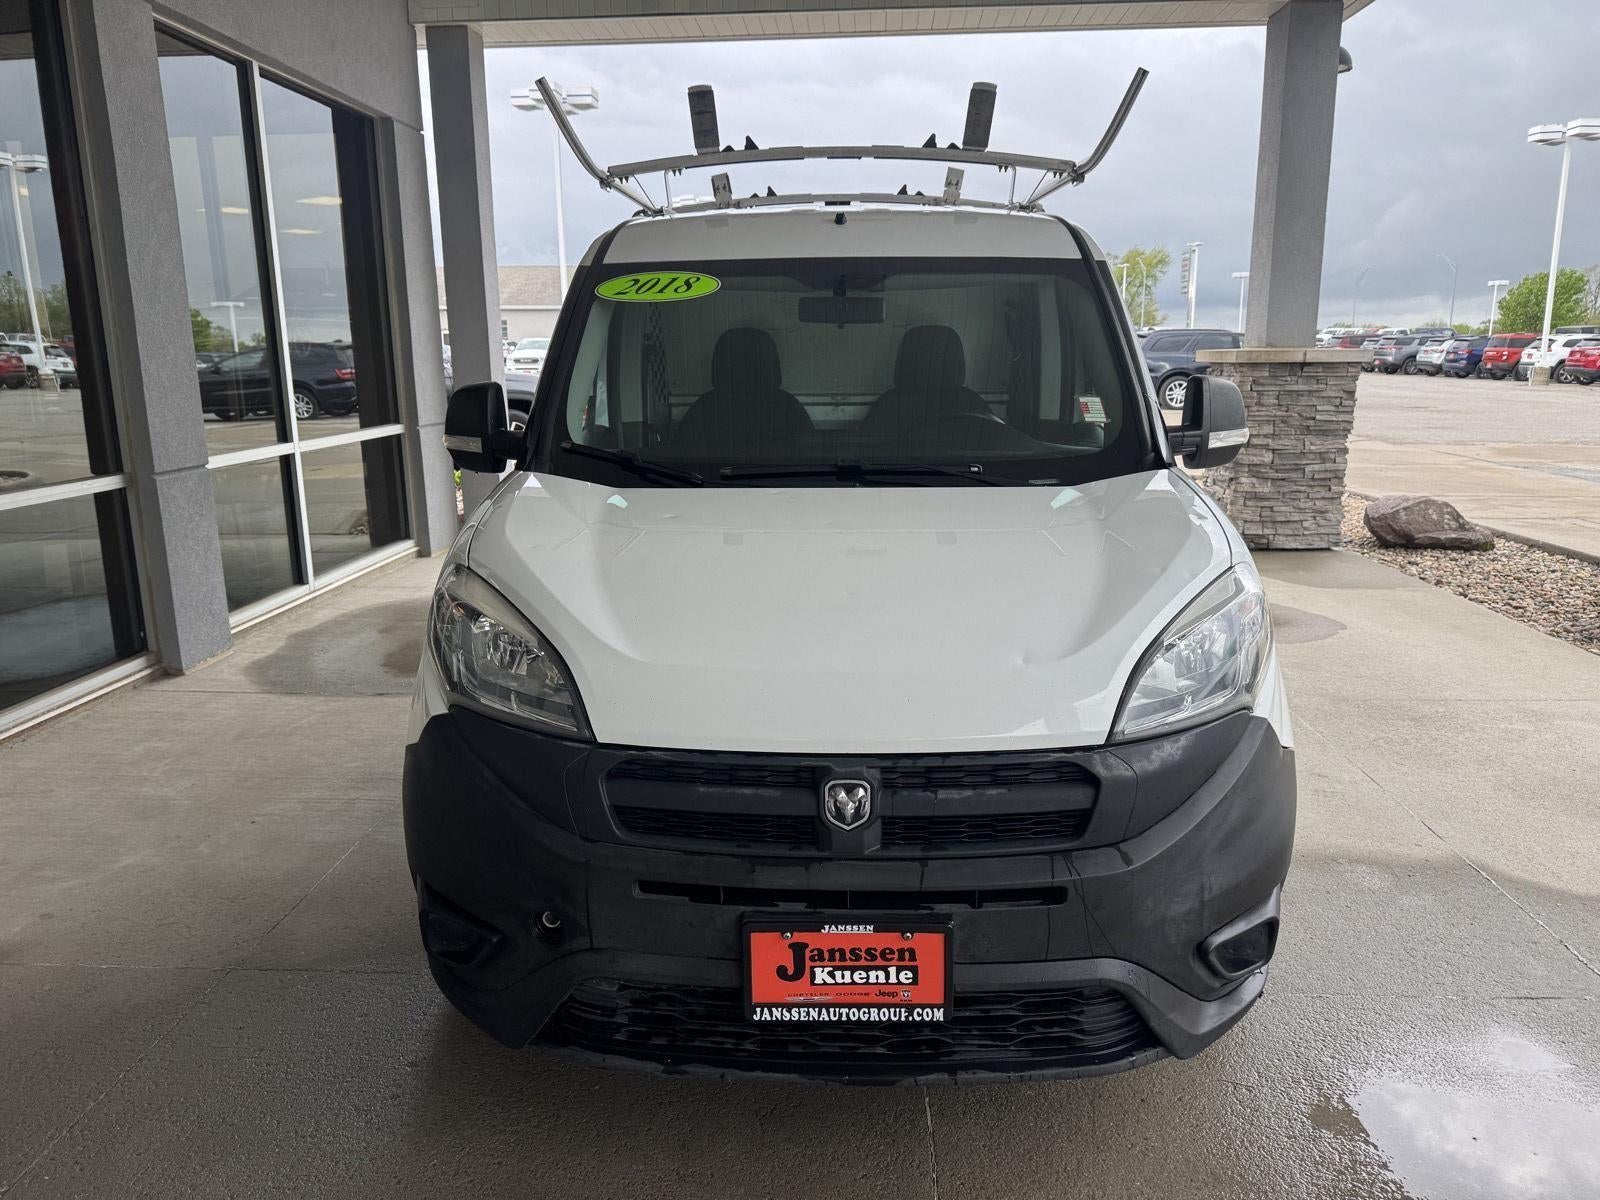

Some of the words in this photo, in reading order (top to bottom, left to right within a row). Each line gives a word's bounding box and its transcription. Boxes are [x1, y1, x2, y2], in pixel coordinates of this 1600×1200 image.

[613, 276, 701, 296] 2018
[821, 924, 874, 933] JANSSEN
[775, 941, 918, 982] Janssen
[813, 966, 913, 984] Kuenle
[874, 989, 898, 999] Jeep
[752, 1007, 945, 1021] JANSSENAUTOGROUP.COM
